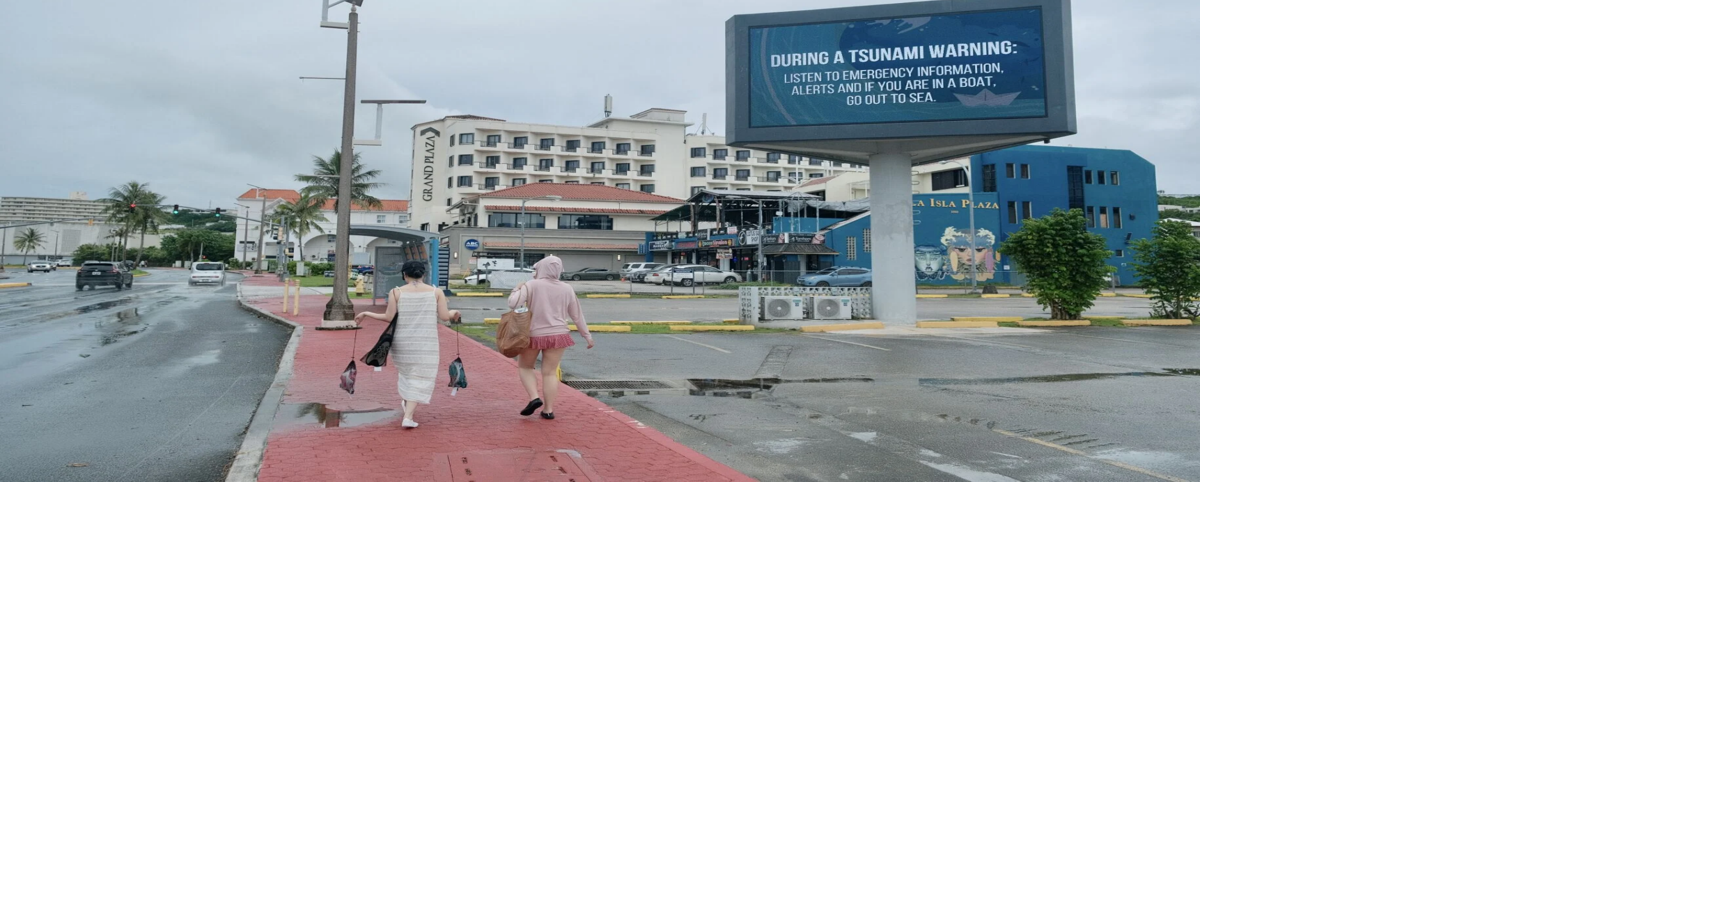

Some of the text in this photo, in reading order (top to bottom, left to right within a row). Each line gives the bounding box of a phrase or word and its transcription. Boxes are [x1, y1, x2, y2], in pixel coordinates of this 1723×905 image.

[771, 40, 1017, 67] DURING A TSUNAMI WARNING:
[784, 62, 1004, 84] LISTEN TO EMERGENCY INFORMATION,
[791, 76, 997, 95] ALERTS AND IF YOU ARE IN A BOAT,
[846, 92, 937, 106] GO OUT TO SEA.
[422, 135, 435, 202] GRAND PLAZA
